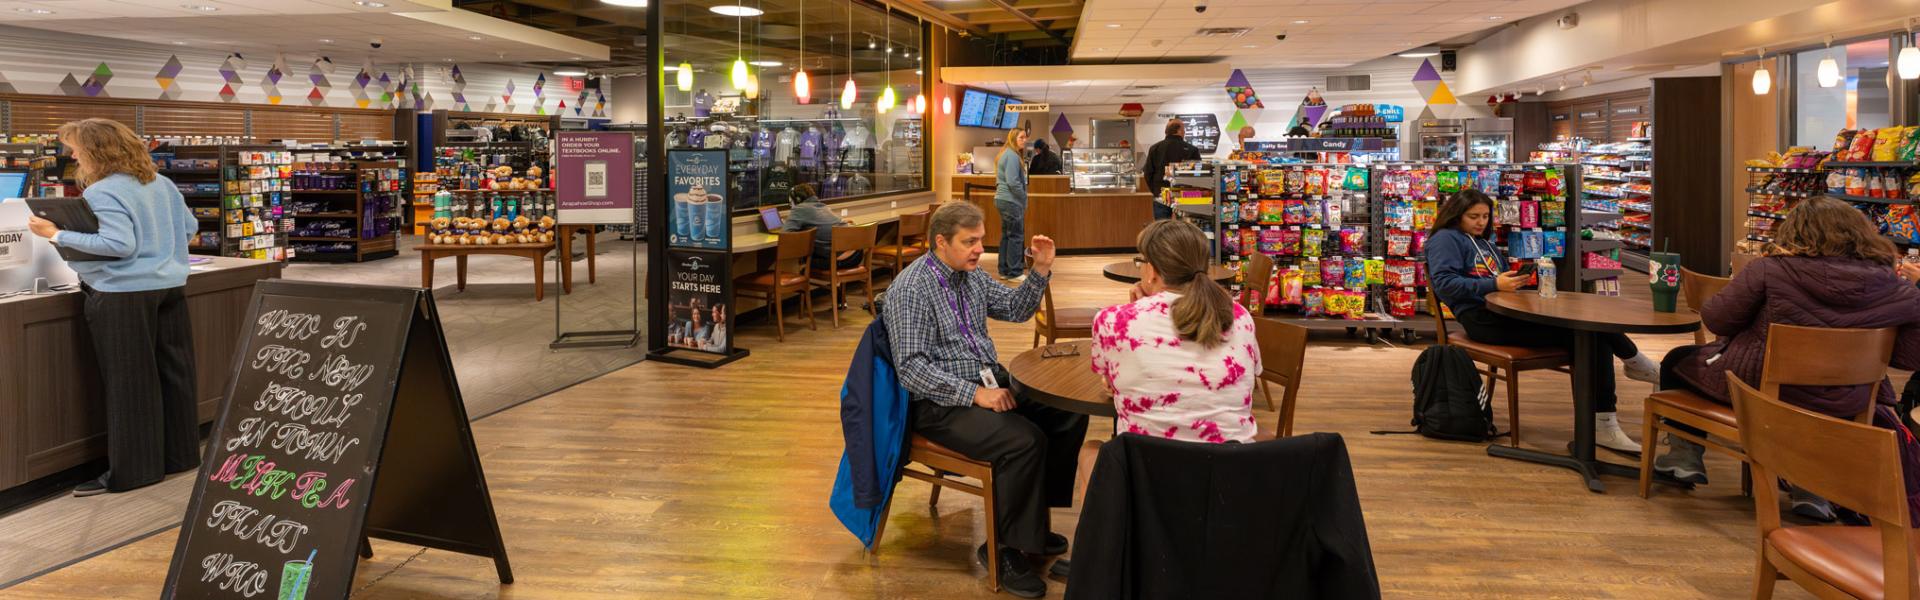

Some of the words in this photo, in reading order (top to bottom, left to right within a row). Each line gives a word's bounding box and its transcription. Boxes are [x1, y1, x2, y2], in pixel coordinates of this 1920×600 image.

[674, 176, 720, 186] FAVORITES
[675, 164, 719, 175] EVERYDAY
[0, 233, 23, 244] ODAY
[672, 281, 699, 292] STARTS
[699, 284, 721, 294] HERE
[677, 271, 698, 281] YOUR
[699, 273, 715, 283] DAY
[258, 309, 321, 341] WHO
[320, 315, 367, 349] IS
[252, 344, 310, 380] THE
[308, 353, 375, 391] NEW
[253, 380, 364, 429] GHOUL
[226, 416, 279, 452] IN
[271, 422, 360, 465] TOWN
[210, 453, 296, 501] MILK
[291, 471, 357, 510] TEA
[206, 500, 309, 554] THATS
[200, 552, 269, 598] WHO
